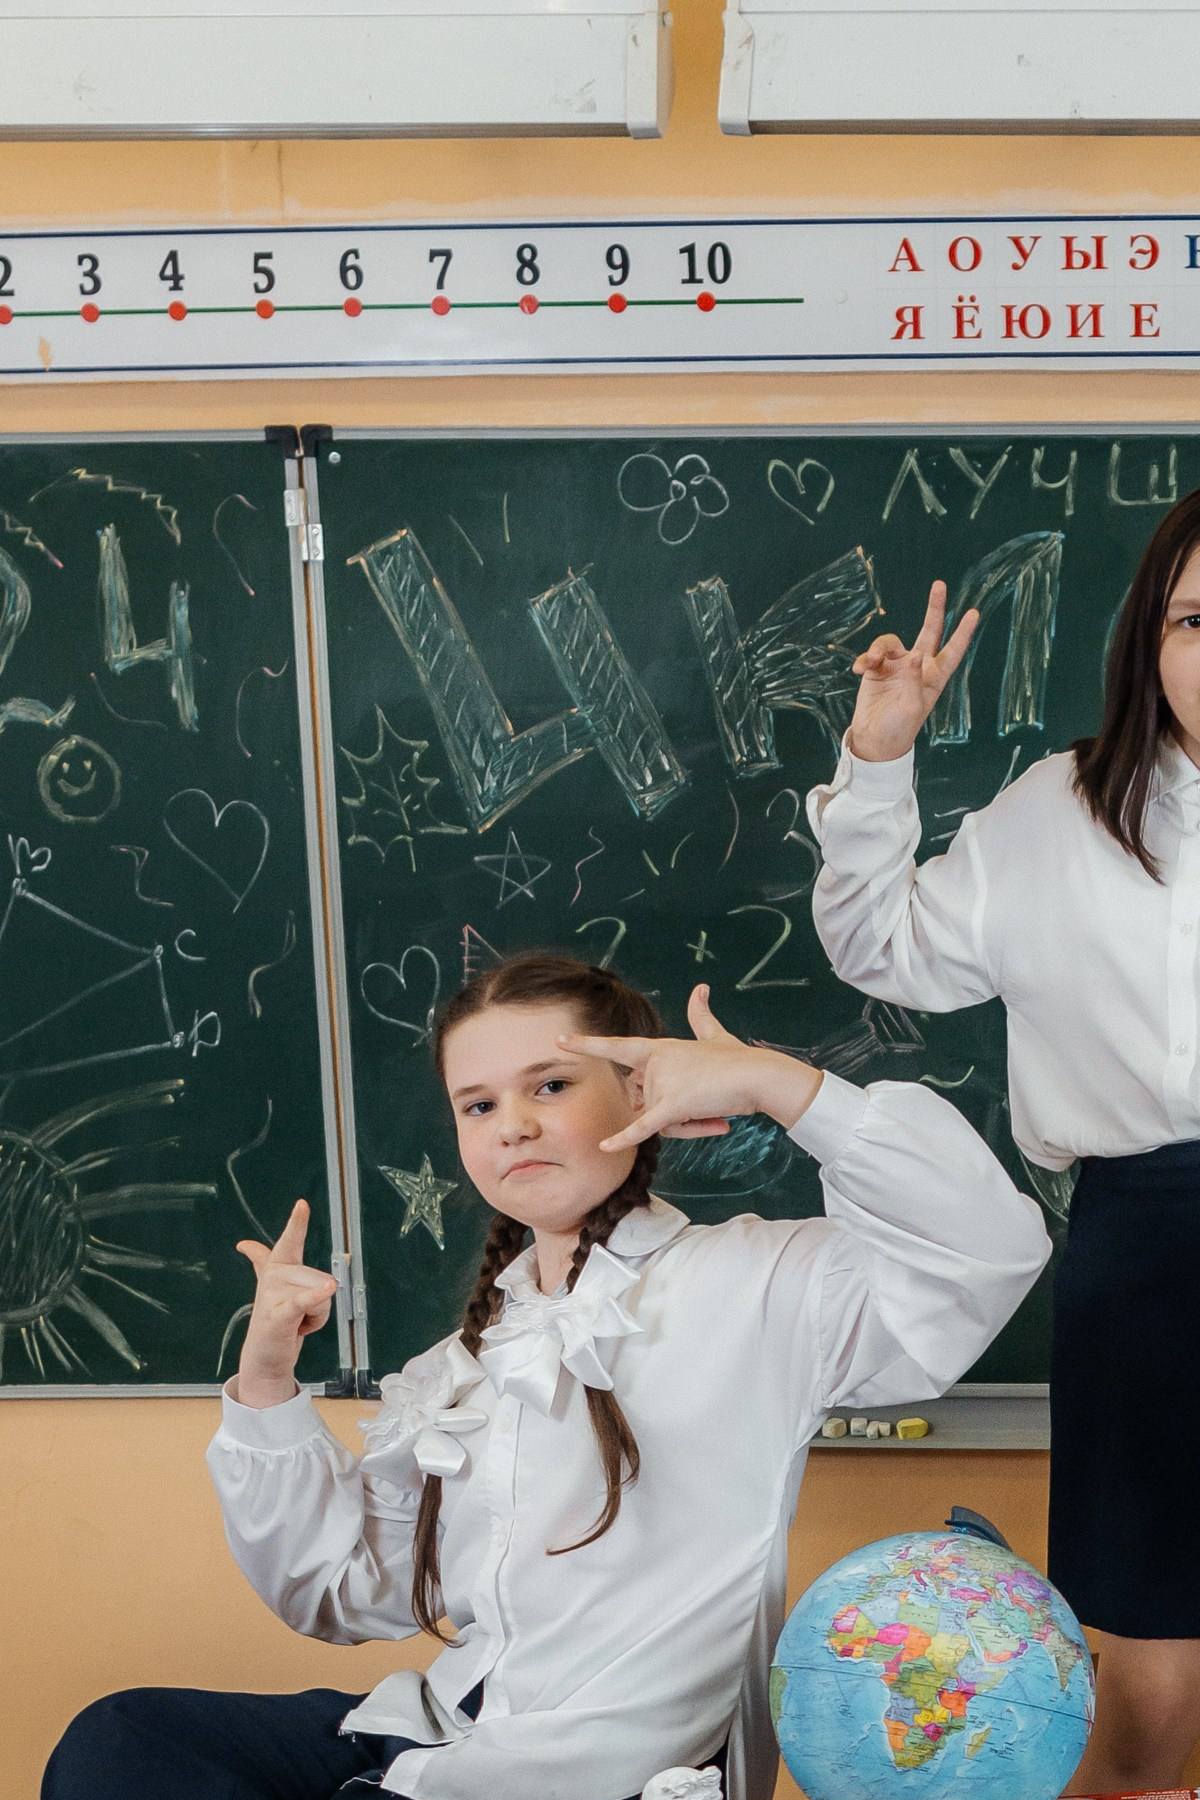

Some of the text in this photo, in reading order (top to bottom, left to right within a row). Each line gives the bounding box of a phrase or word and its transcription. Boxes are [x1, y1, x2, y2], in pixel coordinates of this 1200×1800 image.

[77, 252, 102, 296] 3
[158, 249, 185, 292] 4
[252, 251, 276, 294] 5
[338, 248, 364, 291] 6
[428, 248, 454, 291] 7
[515, 243, 541, 286] 8
[605, 243, 631, 287] 9
[678, 241, 733, 285] 10
[888, 238, 924, 273] А
[948, 236, 983, 272] О
[1006, 235, 1042, 272] У
[1060, 235, 1109, 271] Ы
[1128, 234, 1160, 271] Э
[890, 305, 925, 340] Я
[951, 294, 983, 340] Ё
[1000, 303, 1052, 340] Ю
[1065, 303, 1105, 339] И
[1129, 303, 1161, 339] Е
